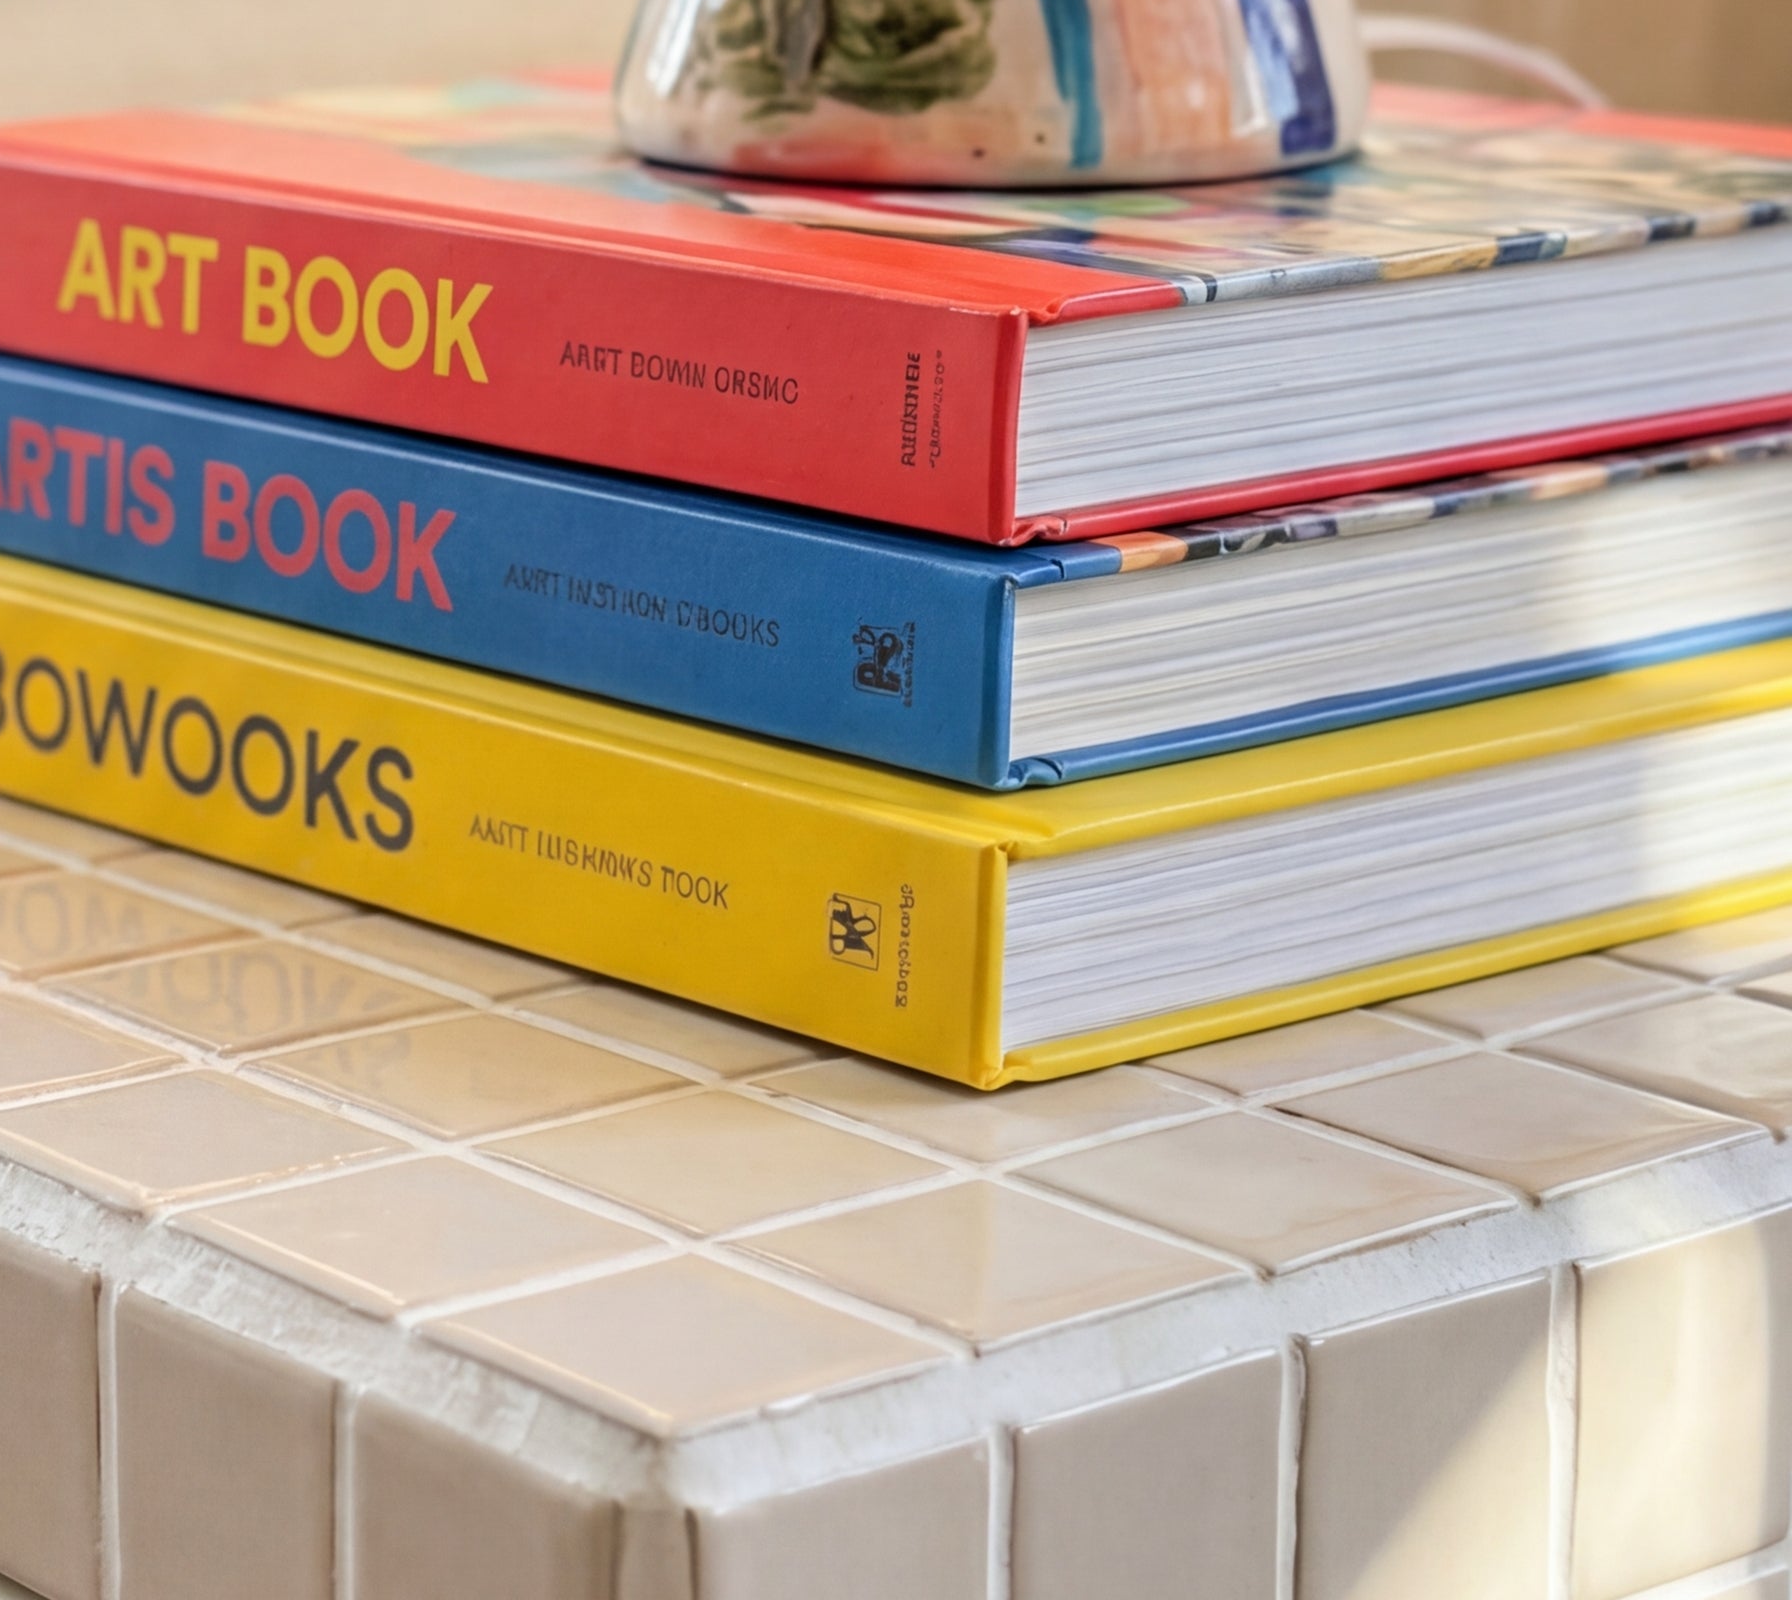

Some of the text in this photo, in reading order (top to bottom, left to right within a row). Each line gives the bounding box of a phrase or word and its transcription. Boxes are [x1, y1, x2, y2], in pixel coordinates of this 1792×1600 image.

[57, 218, 219, 334] ART
[242, 246, 494, 384] BOOK
[202, 460, 457, 612] BOOK
